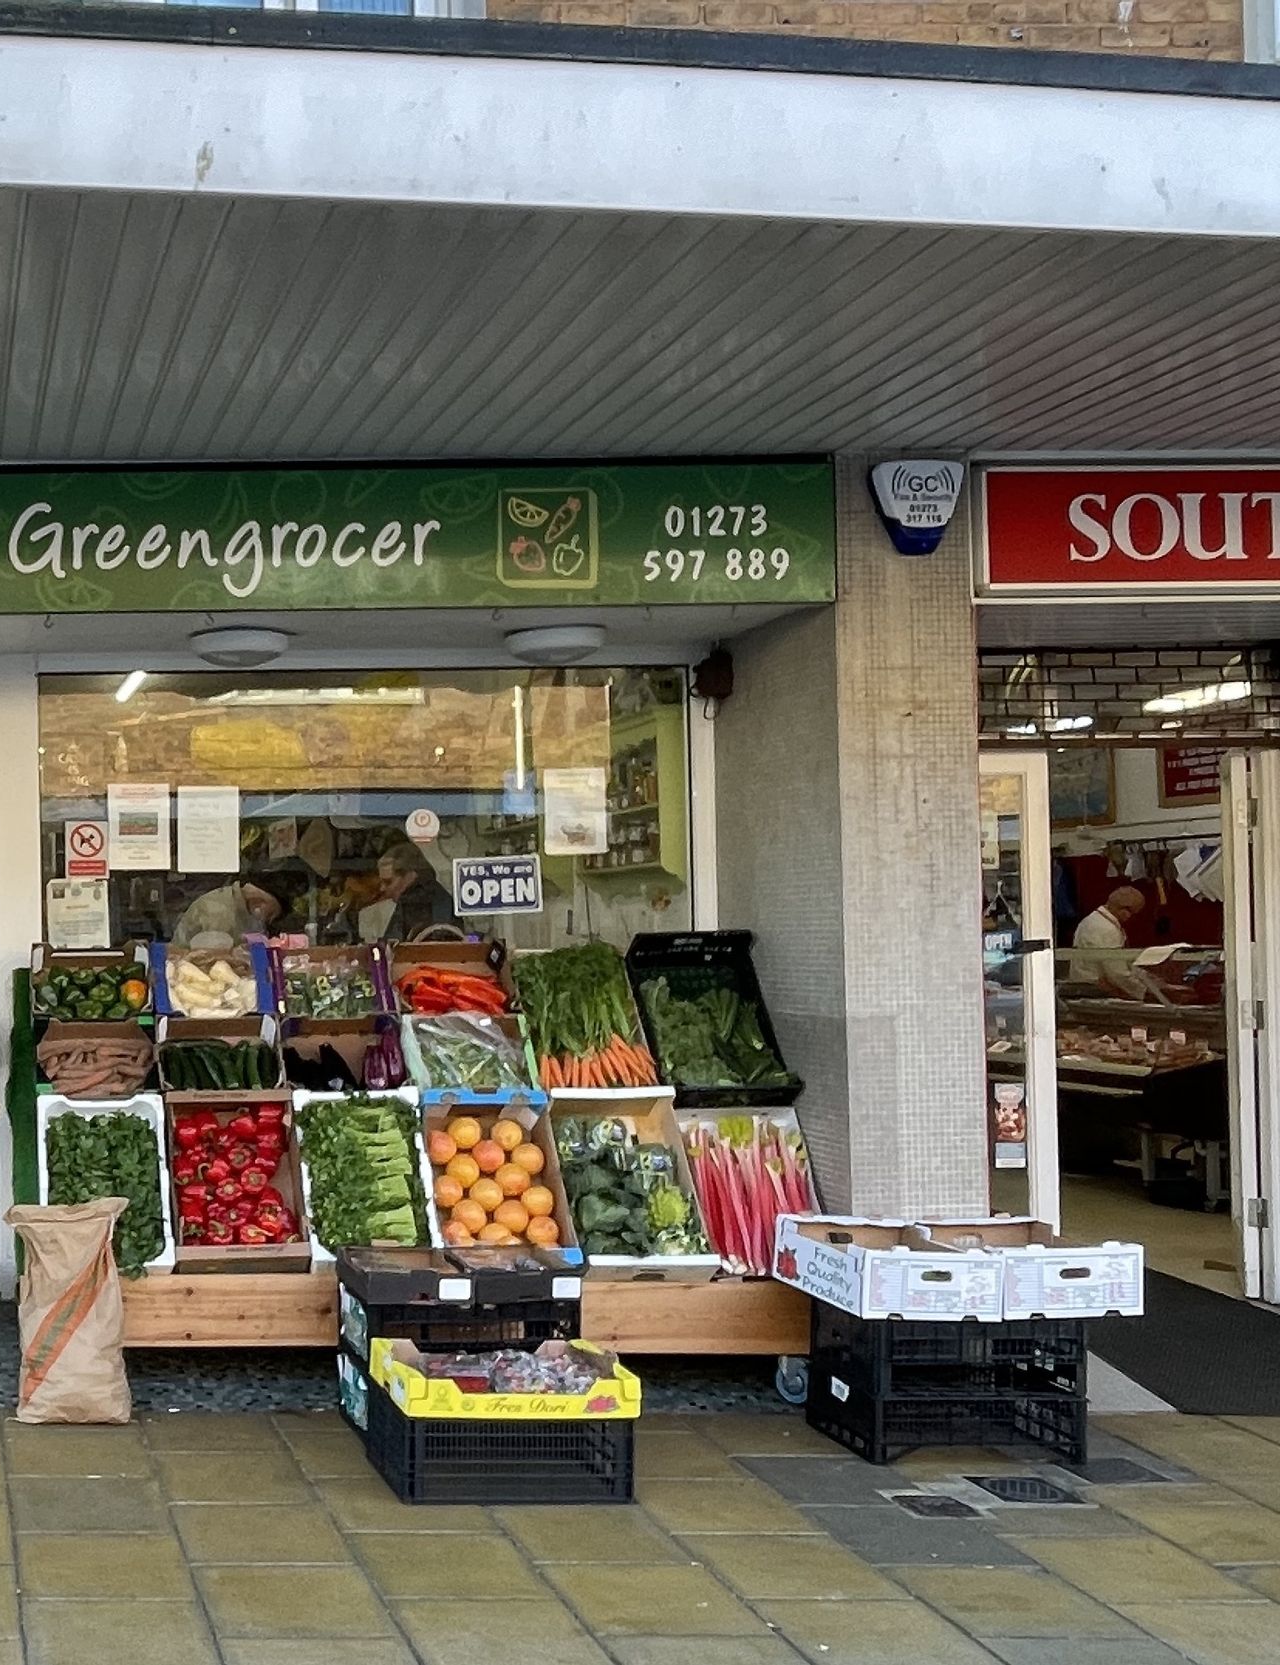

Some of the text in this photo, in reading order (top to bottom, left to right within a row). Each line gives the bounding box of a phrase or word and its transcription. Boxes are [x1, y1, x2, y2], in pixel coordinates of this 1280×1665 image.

[908, 475, 939, 493] GC
[664, 504, 769, 537] 01273
[909, 503, 938, 513] 01273
[8, 501, 443, 599] Greengrocer
[643, 547, 791, 582] 597 889
[491, 865, 511, 875] We
[461, 877, 536, 906] OPEN
[813, 1246, 848, 1272] Fresh
[802, 1276, 855, 1309] Produce
[807, 1261, 853, 1294] Quality
